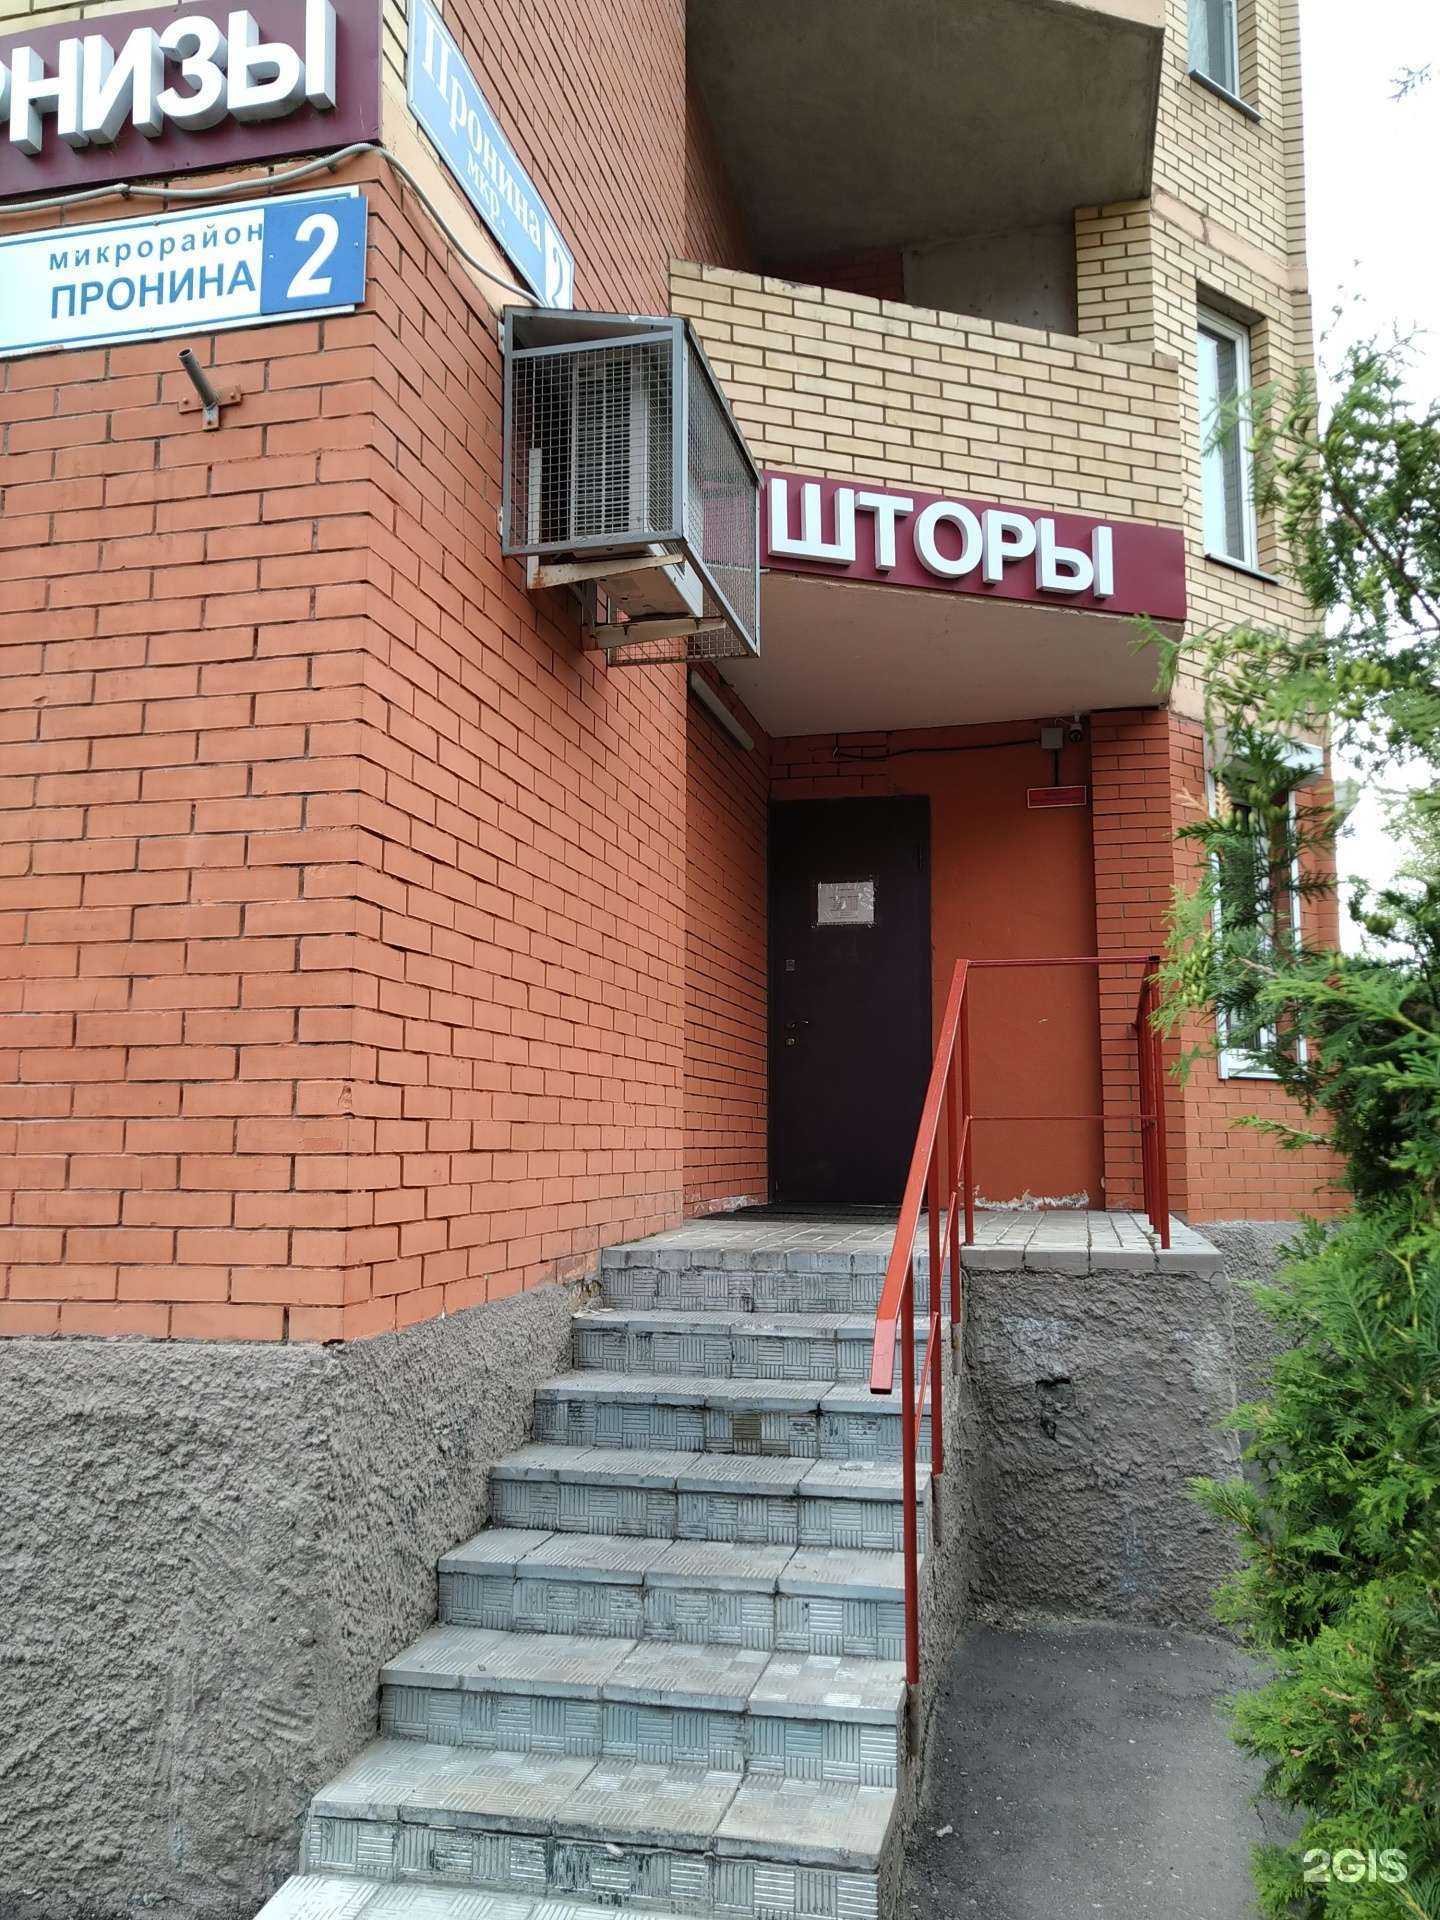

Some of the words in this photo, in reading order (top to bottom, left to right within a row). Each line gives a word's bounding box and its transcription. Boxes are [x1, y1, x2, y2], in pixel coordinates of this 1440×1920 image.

[0, 0, 337, 155] НИЗЫ
[422, 8, 542, 254] Пронина
[466, 150, 506, 230] мкр.
[49, 221, 263, 271] микрорайон
[286, 213, 340, 299] 2
[51, 260, 256, 319] ПРОНИНА
[767, 478, 1114, 598] ШТОРЫ
